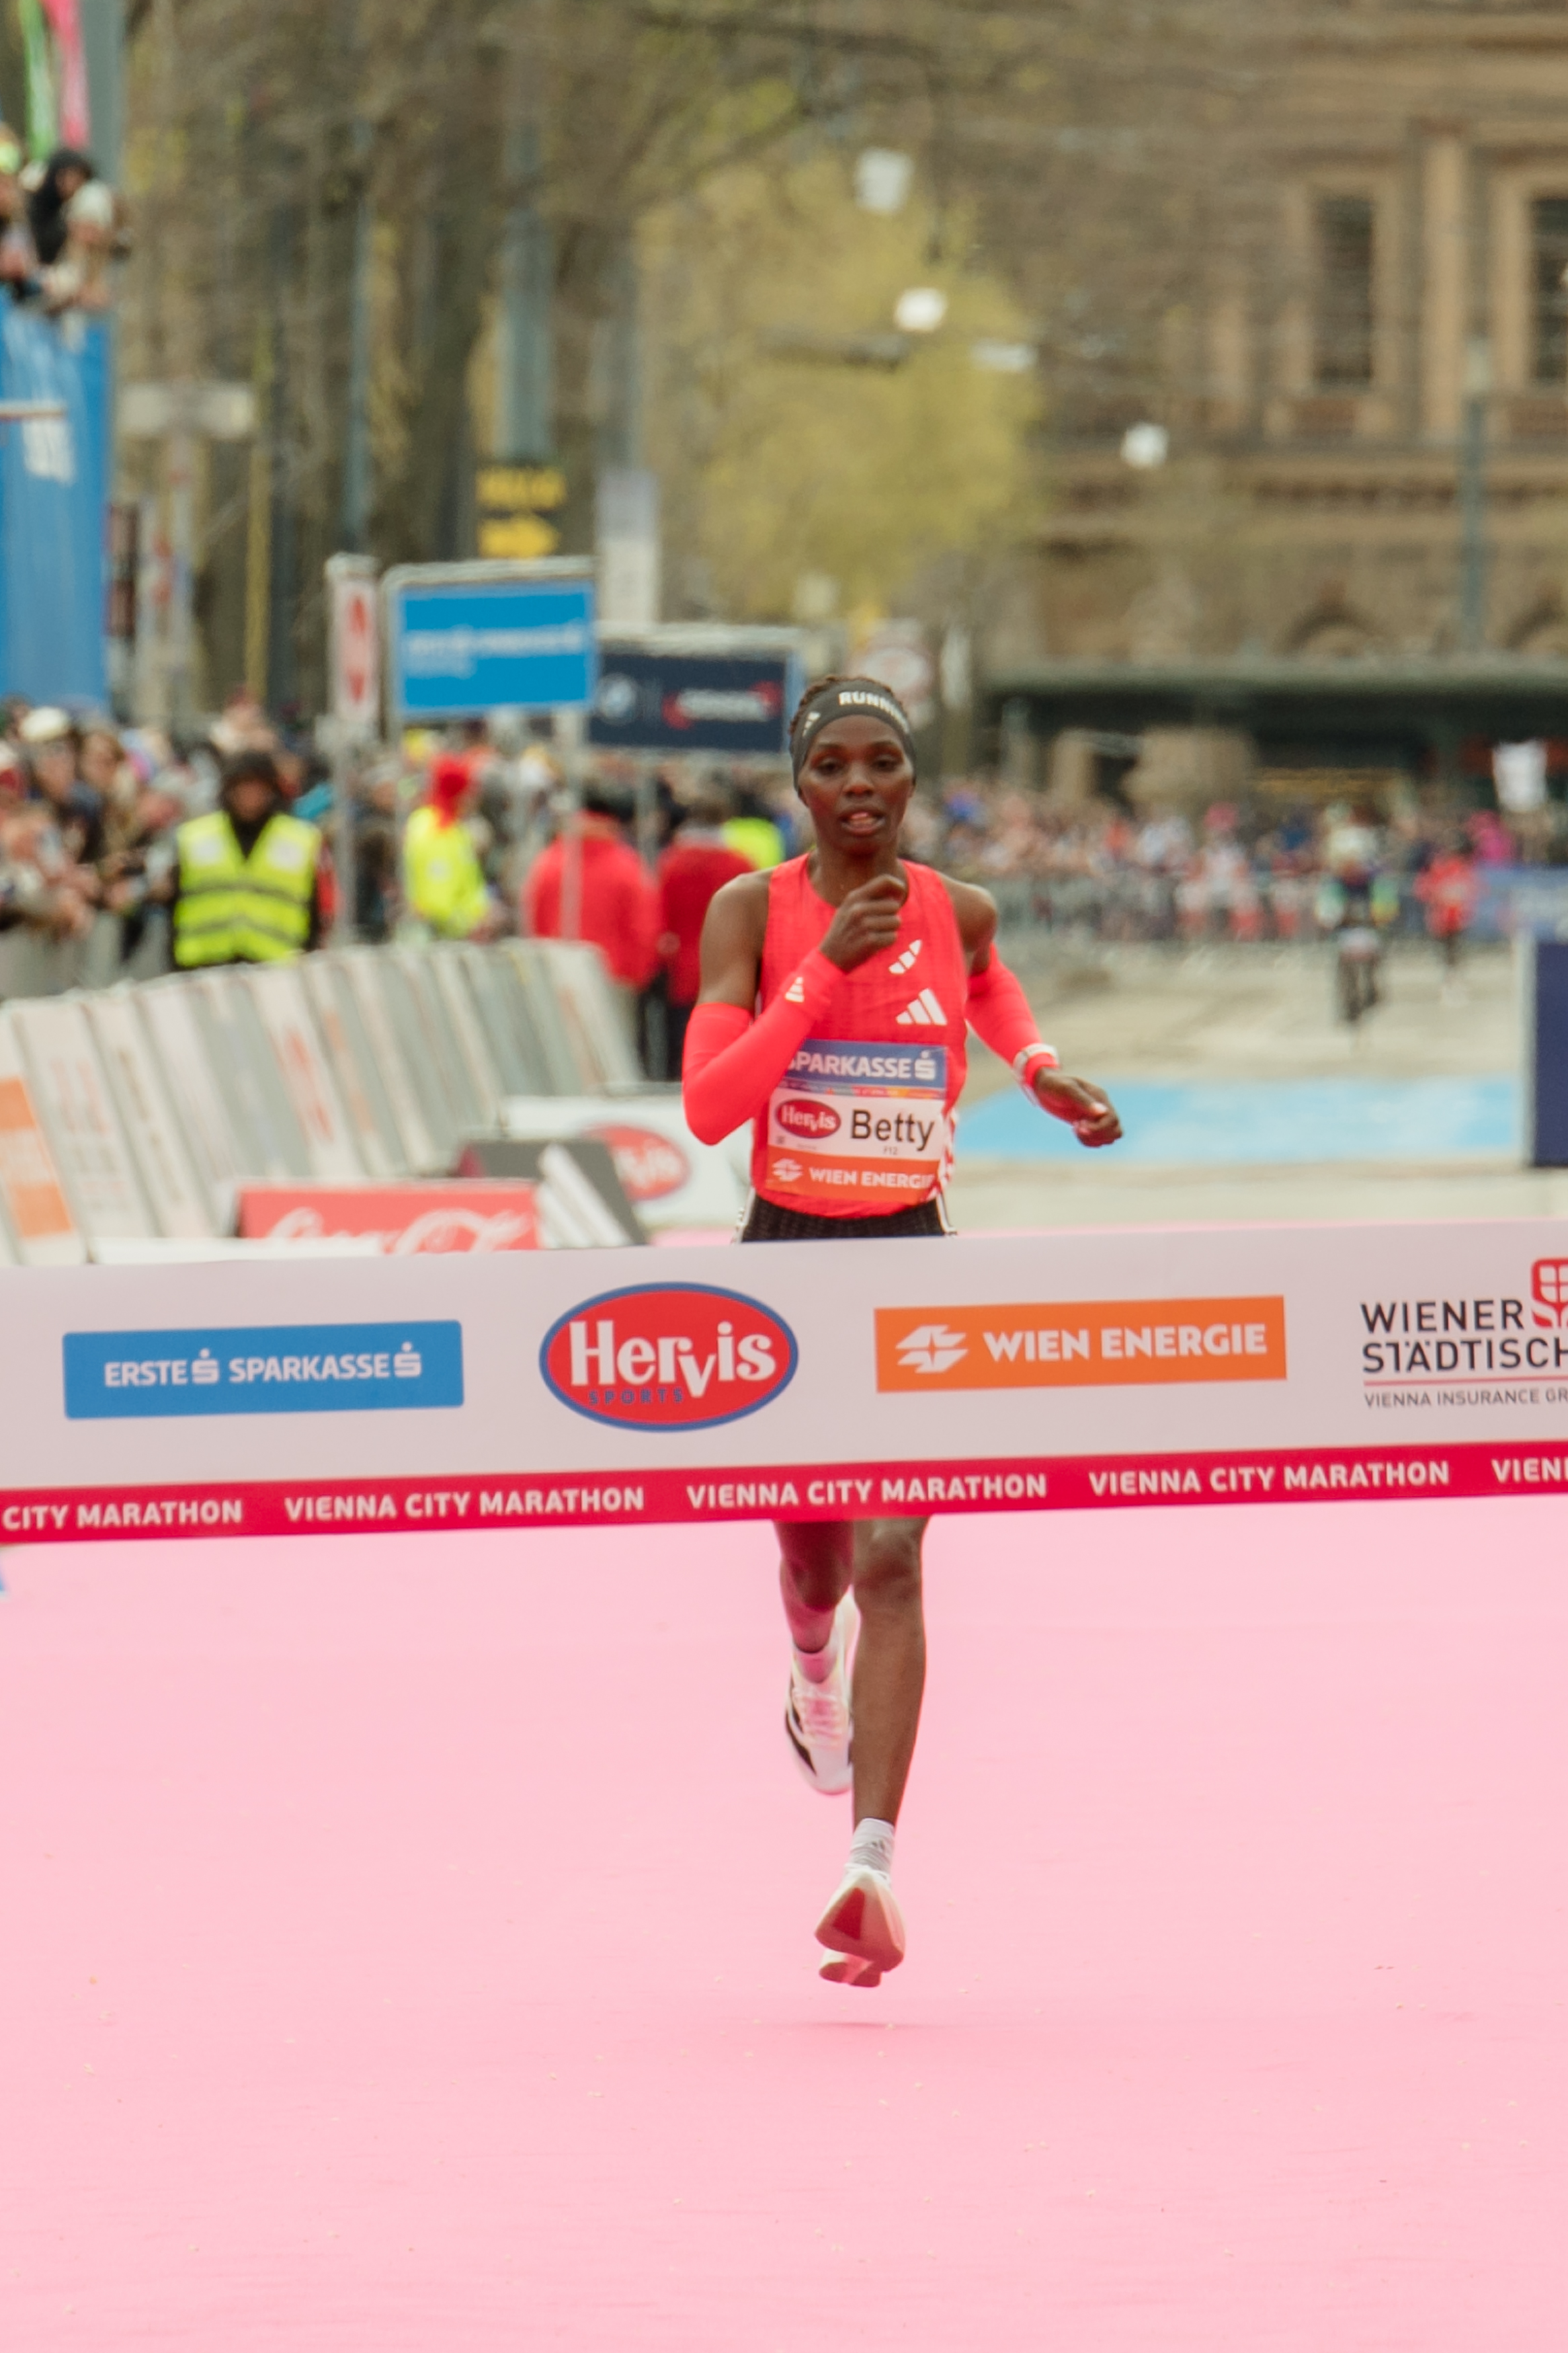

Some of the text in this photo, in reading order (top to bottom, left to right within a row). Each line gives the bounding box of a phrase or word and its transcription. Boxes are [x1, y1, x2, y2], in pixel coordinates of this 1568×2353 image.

[781, 1104, 837, 1132] Hervis
[851, 1110, 935, 1152] Betty
[809, 1166, 857, 1185] WIEN
[1360, 1299, 1525, 1334] WIENER
[569, 1320, 777, 1398] Hervis
[982, 1323, 1268, 1362] WIEN ENERGIE
[589, 1388, 684, 1404] SPORTS
[1364, 1391, 1432, 1408] VIENNA
[1436, 1388, 1540, 1406] INSURANCE
[1087, 1462, 1450, 1496] VIENNA CITY MARATHON
[1491, 1456, 1568, 1483] VIEN
[284, 1486, 645, 1521] VIENNA CITY MARATHON
[686, 1473, 1047, 1509] VIENNA CITY MARATHON
[2, 1500, 243, 1530] CITY MARATHON
